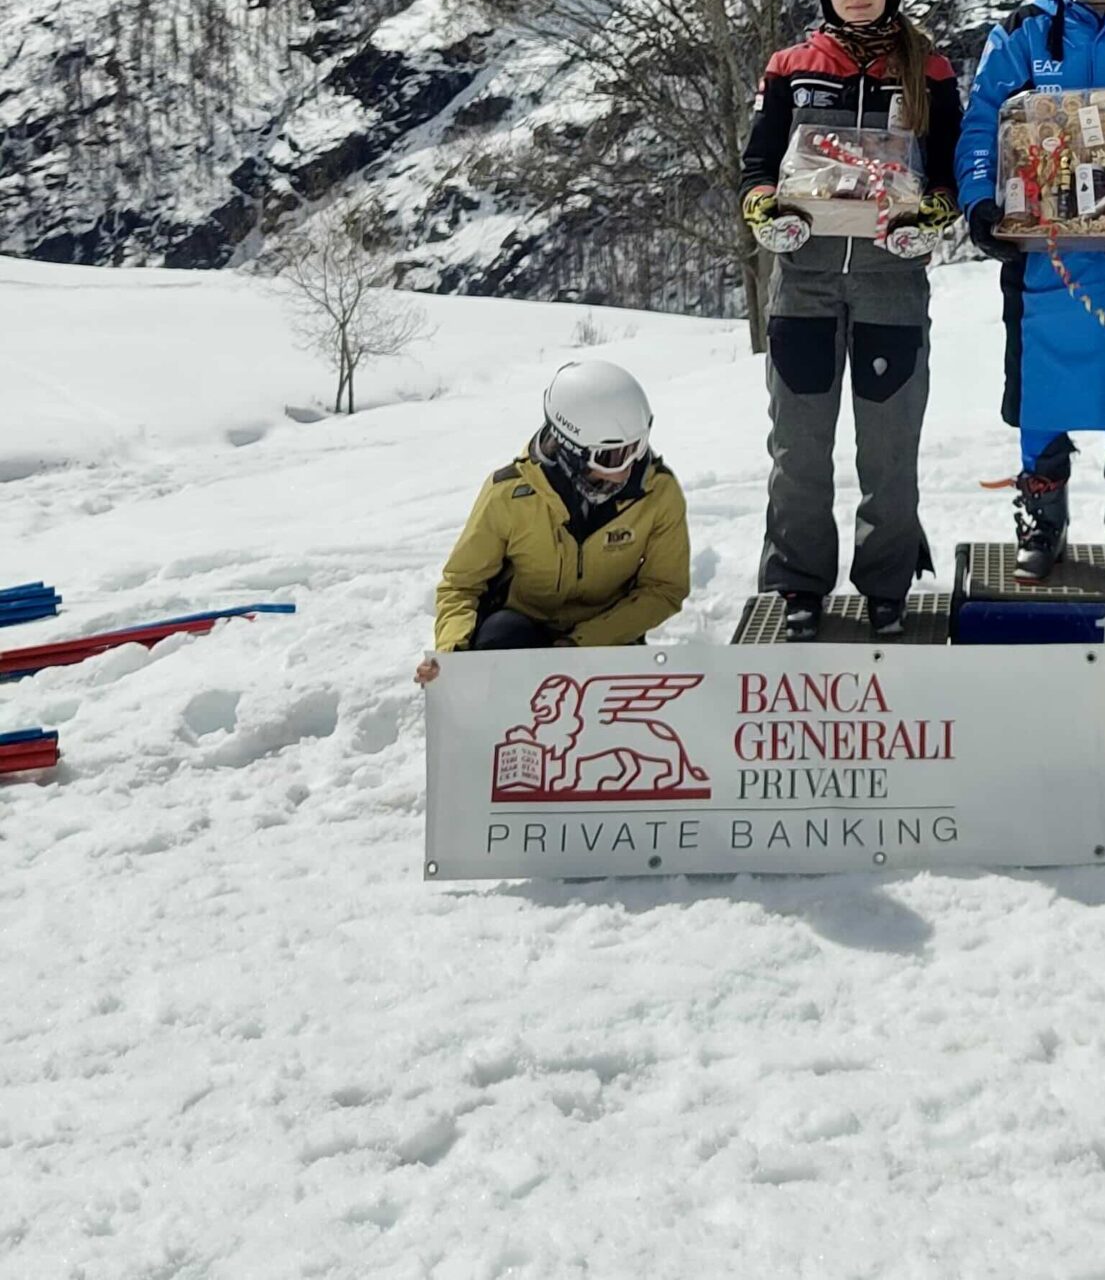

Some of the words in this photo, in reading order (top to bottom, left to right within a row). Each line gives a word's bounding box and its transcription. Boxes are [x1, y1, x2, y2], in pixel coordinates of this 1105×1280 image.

[1033, 59, 1063, 72] EA7
[555, 411, 581, 436] uvex
[737, 672, 893, 712] BANCA
[734, 720, 956, 762] GENERALI
[737, 767, 888, 800] PRIVATE
[487, 821, 700, 853] PRIVATE
[731, 815, 959, 849] BANKING
